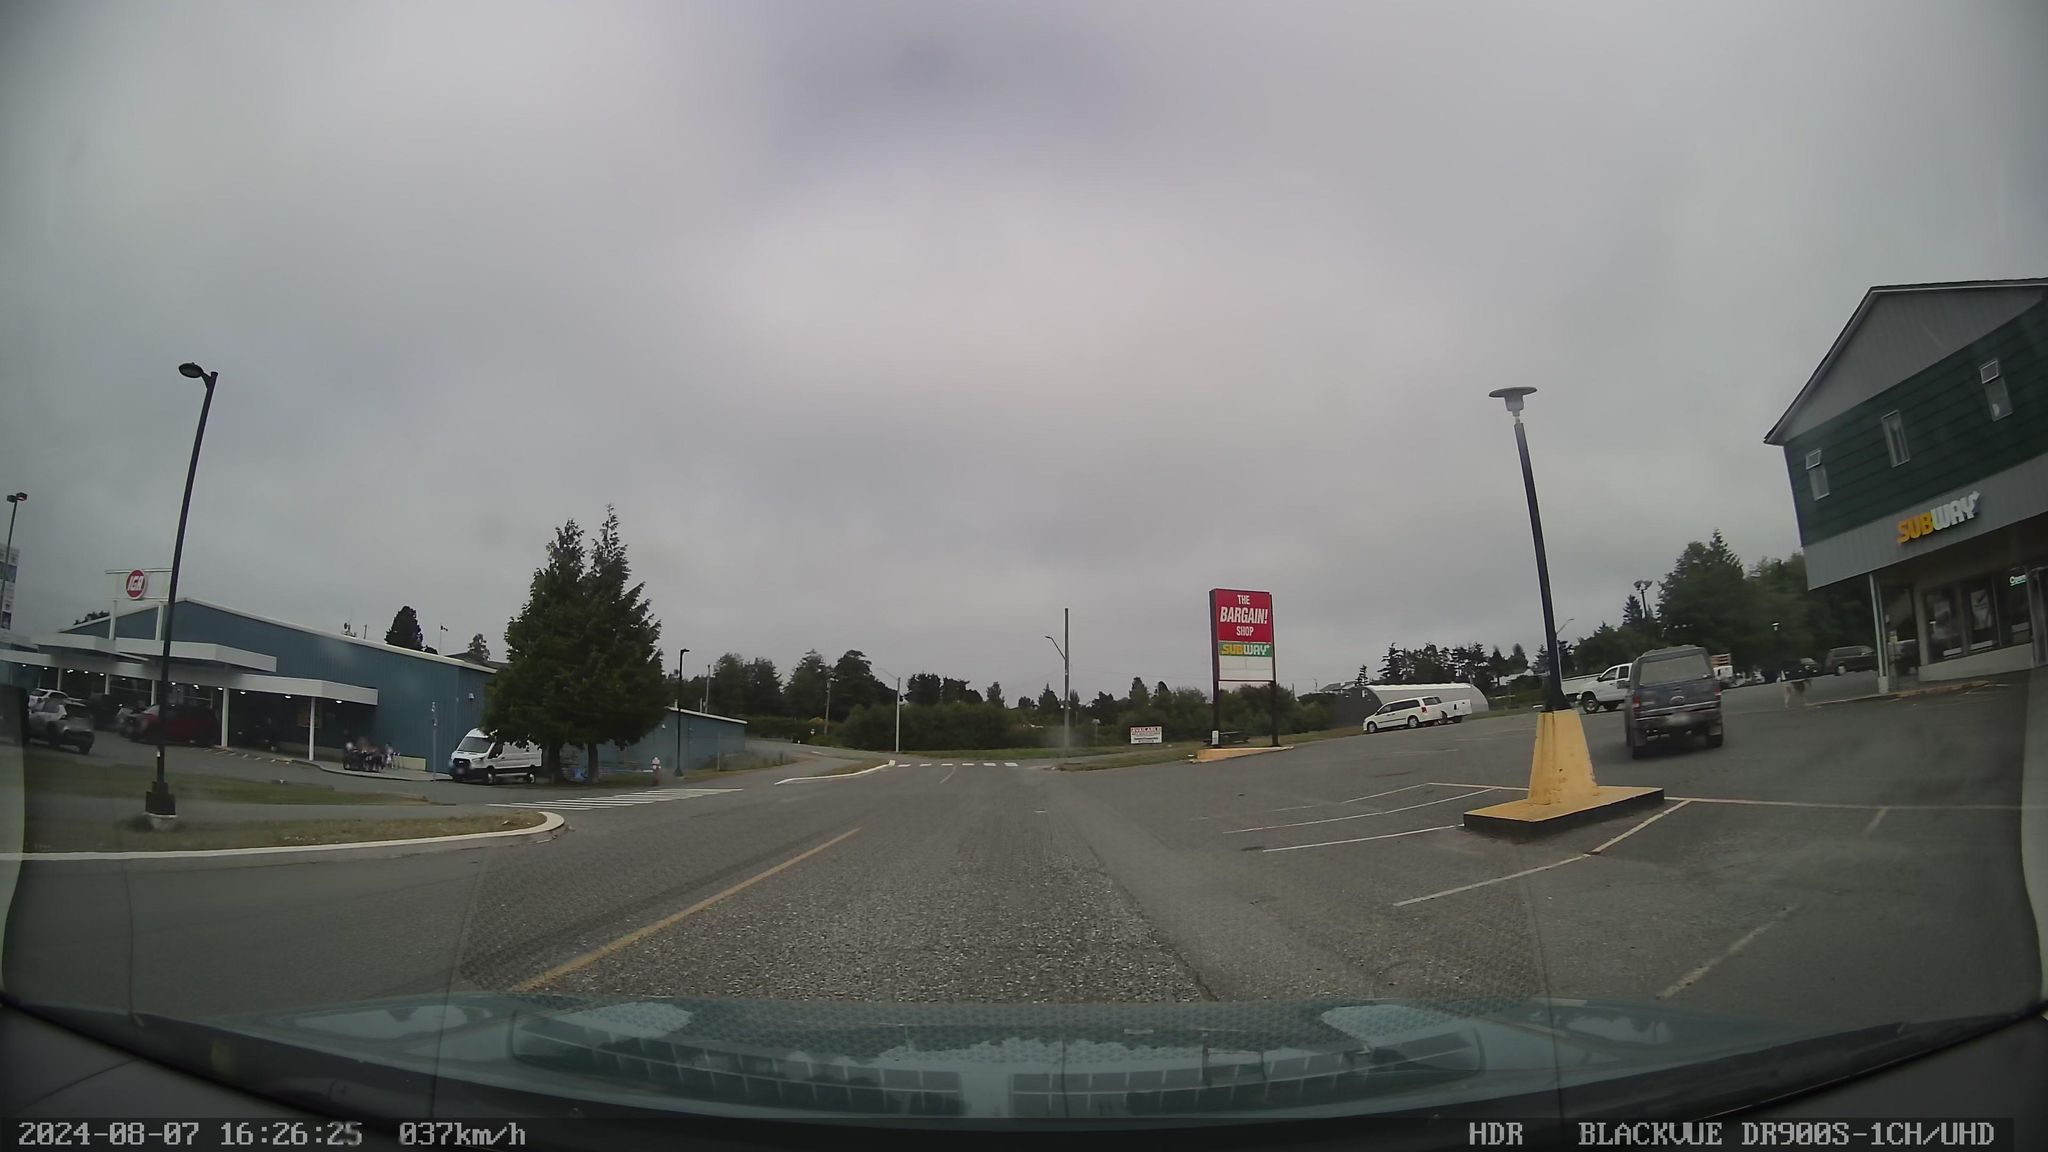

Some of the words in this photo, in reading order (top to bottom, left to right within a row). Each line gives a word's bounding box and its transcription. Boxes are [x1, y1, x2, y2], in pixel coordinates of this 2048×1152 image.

[1897, 491, 1980, 544] SUBWAY
[127, 575, 144, 591] IGA
[1237, 594, 1250, 605] THE
[1220, 606, 1268, 624] BARGAIN!
[1236, 625, 1254, 636] SHOP
[1221, 643, 1270, 655] SUBWAY
